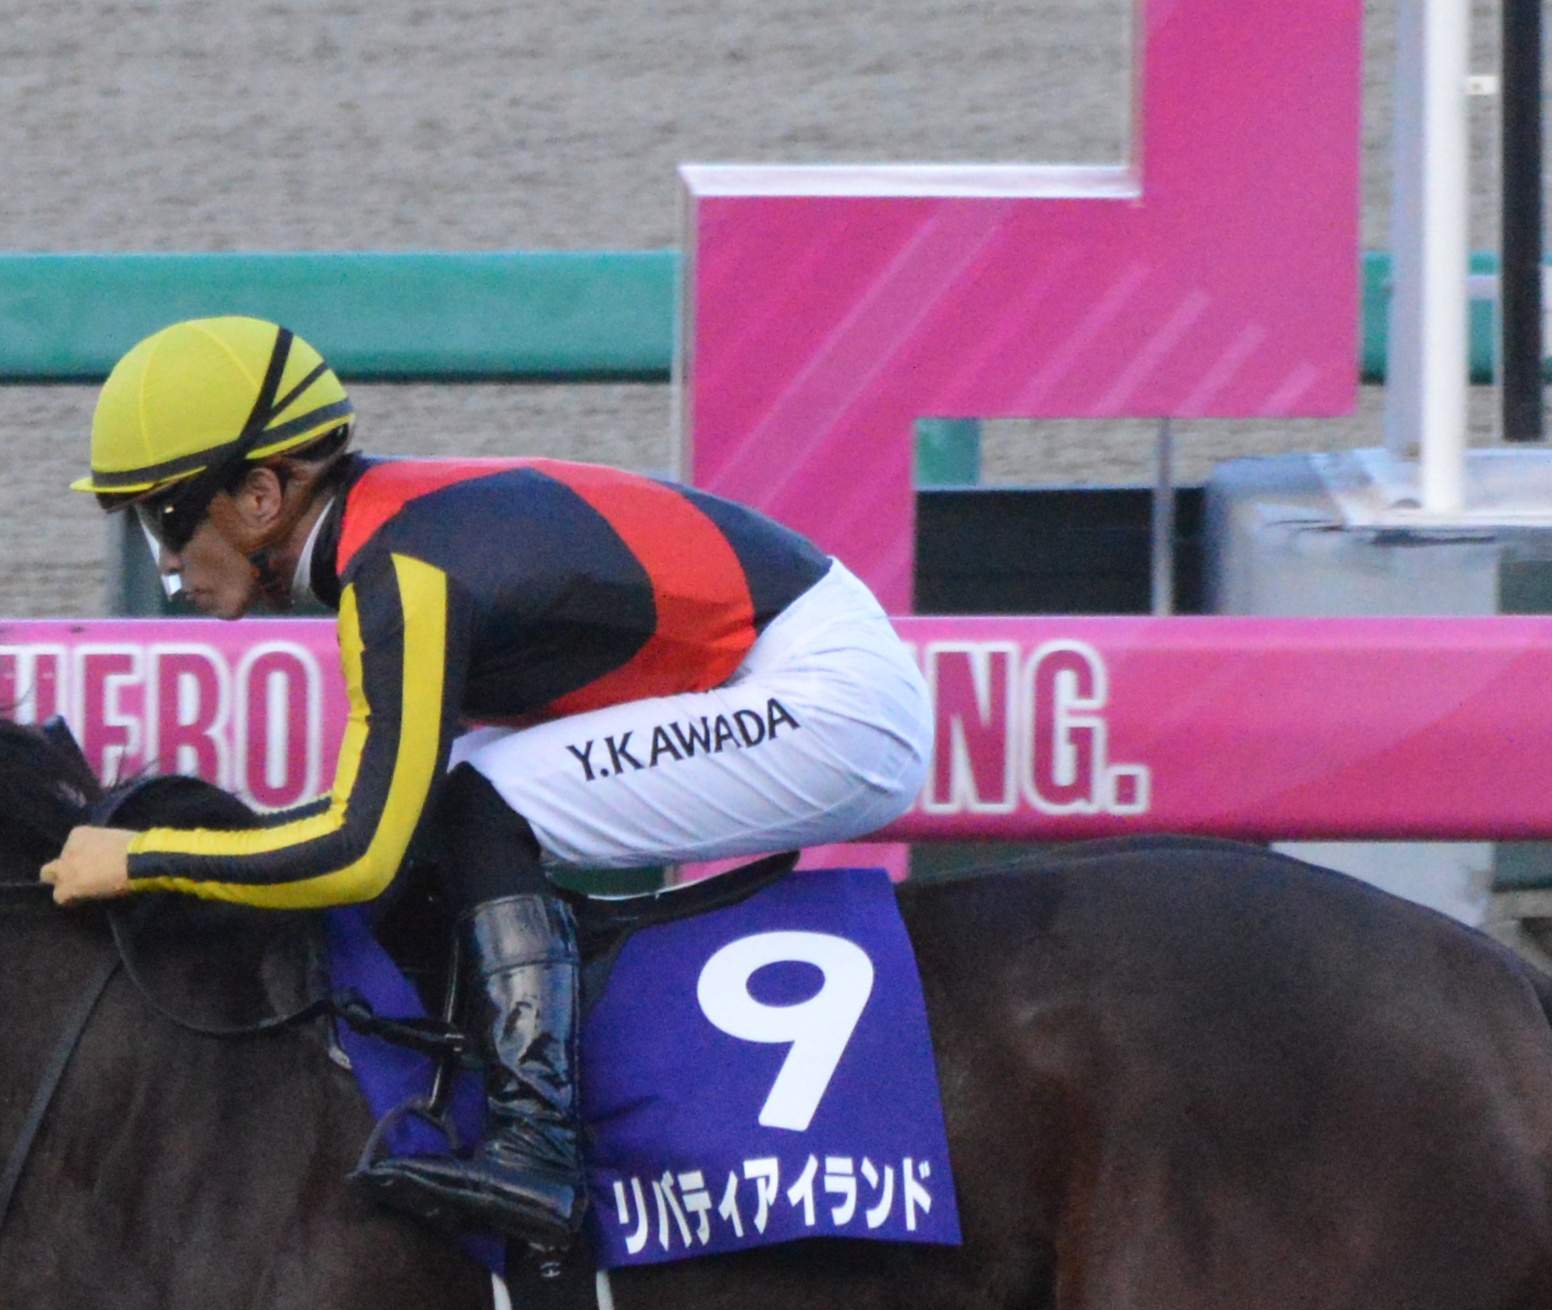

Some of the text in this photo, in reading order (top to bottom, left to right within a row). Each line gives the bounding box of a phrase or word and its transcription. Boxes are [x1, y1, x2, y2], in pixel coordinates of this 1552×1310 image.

[565, 697, 801, 781] Y.KAWADA
[900, 638, 1150, 815] NG.
[697, 930, 874, 1132] 9
[612, 1154, 932, 1255] リバティアイランド
